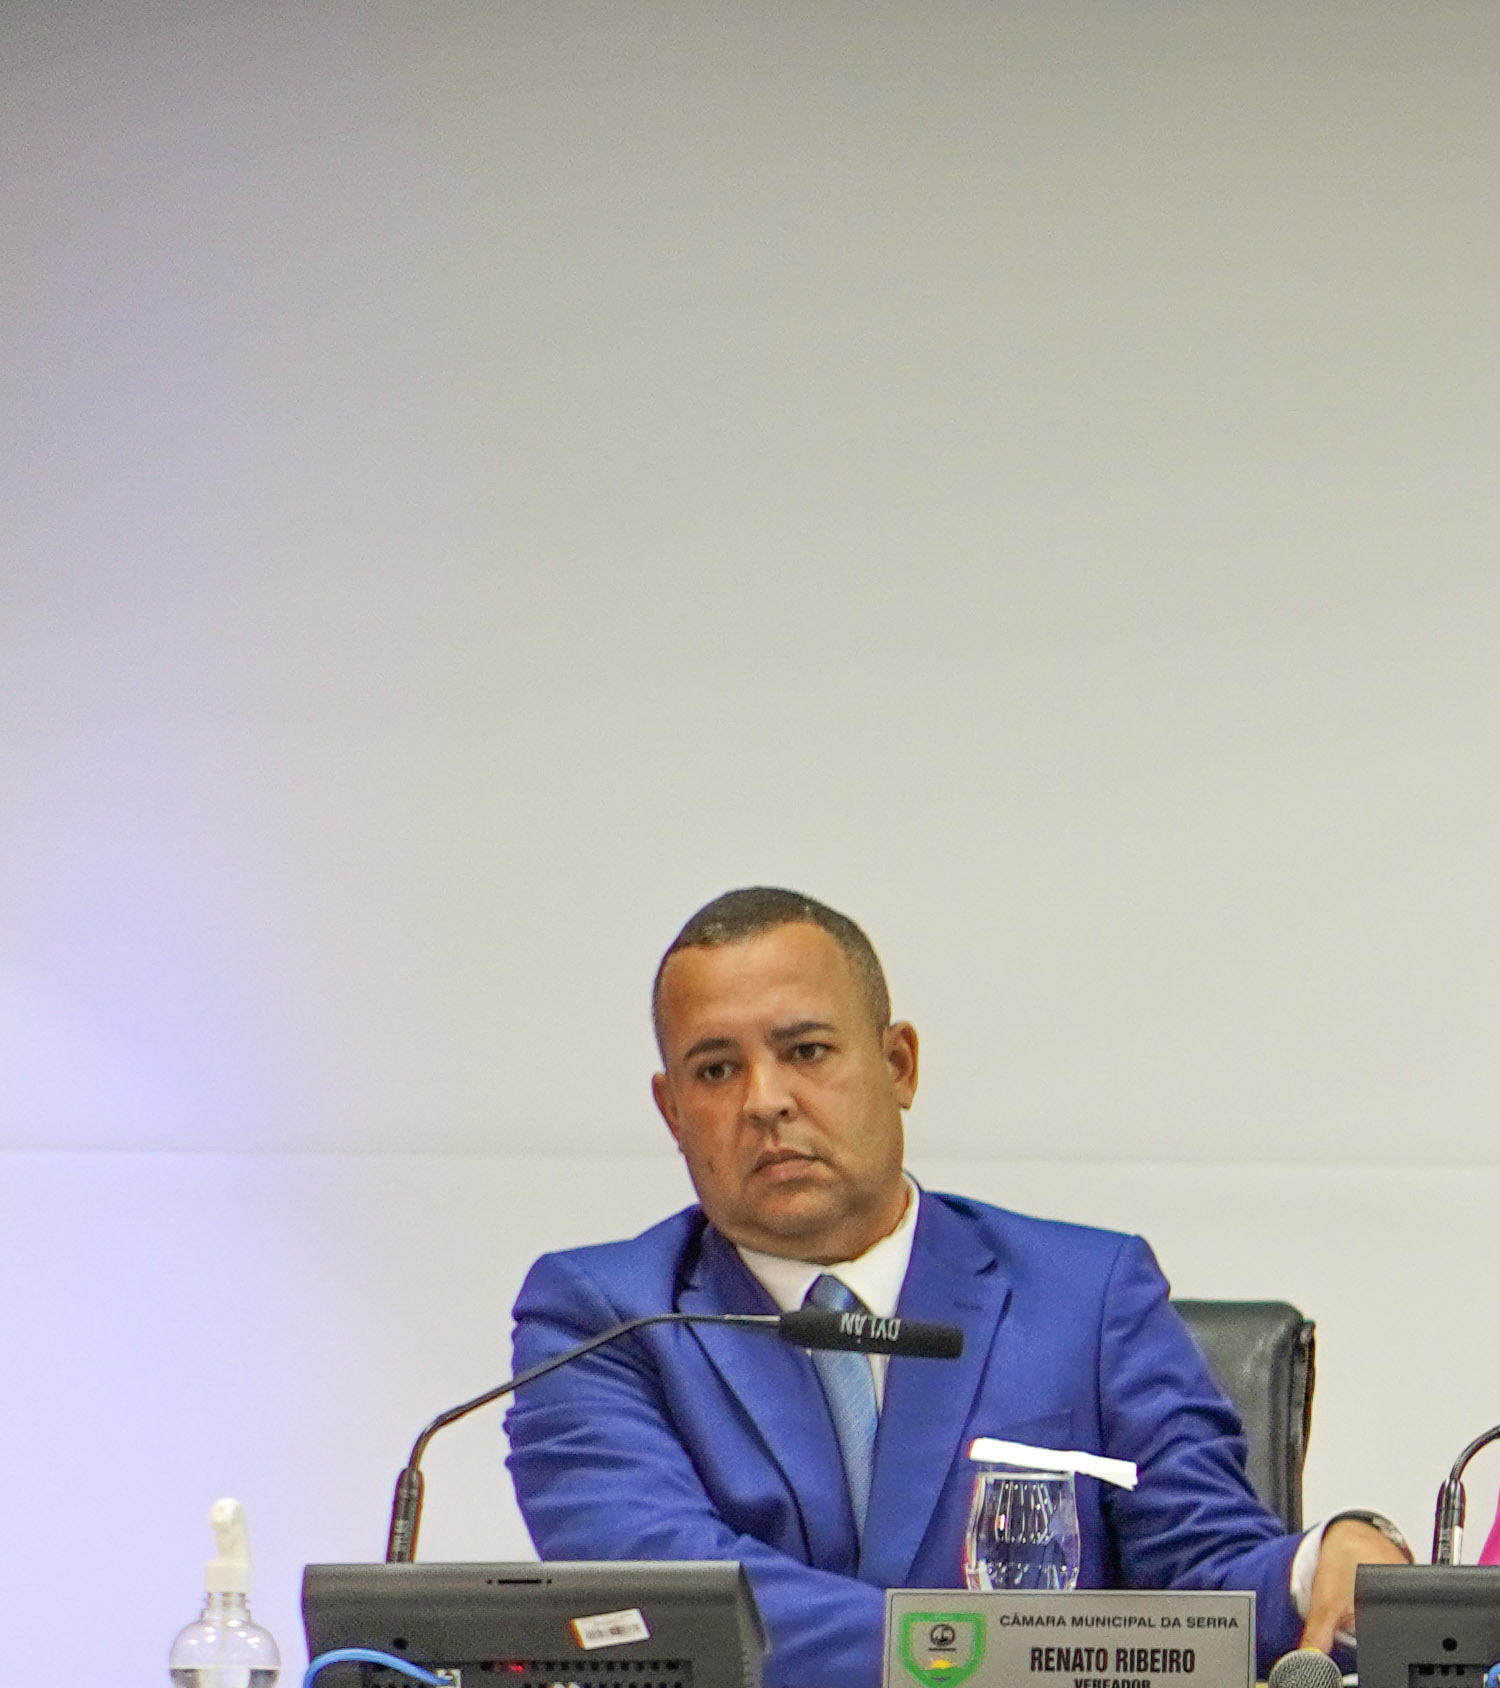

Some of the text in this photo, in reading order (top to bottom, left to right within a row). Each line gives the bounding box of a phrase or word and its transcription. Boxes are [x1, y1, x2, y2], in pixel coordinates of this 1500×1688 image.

[1071, 1615, 1156, 1629] MUNICIPAL
[1161, 1616, 1181, 1629] DA
[1186, 1616, 1239, 1630] SERRA
[1030, 1647, 1195, 1674] RENATO RIBEIRO
